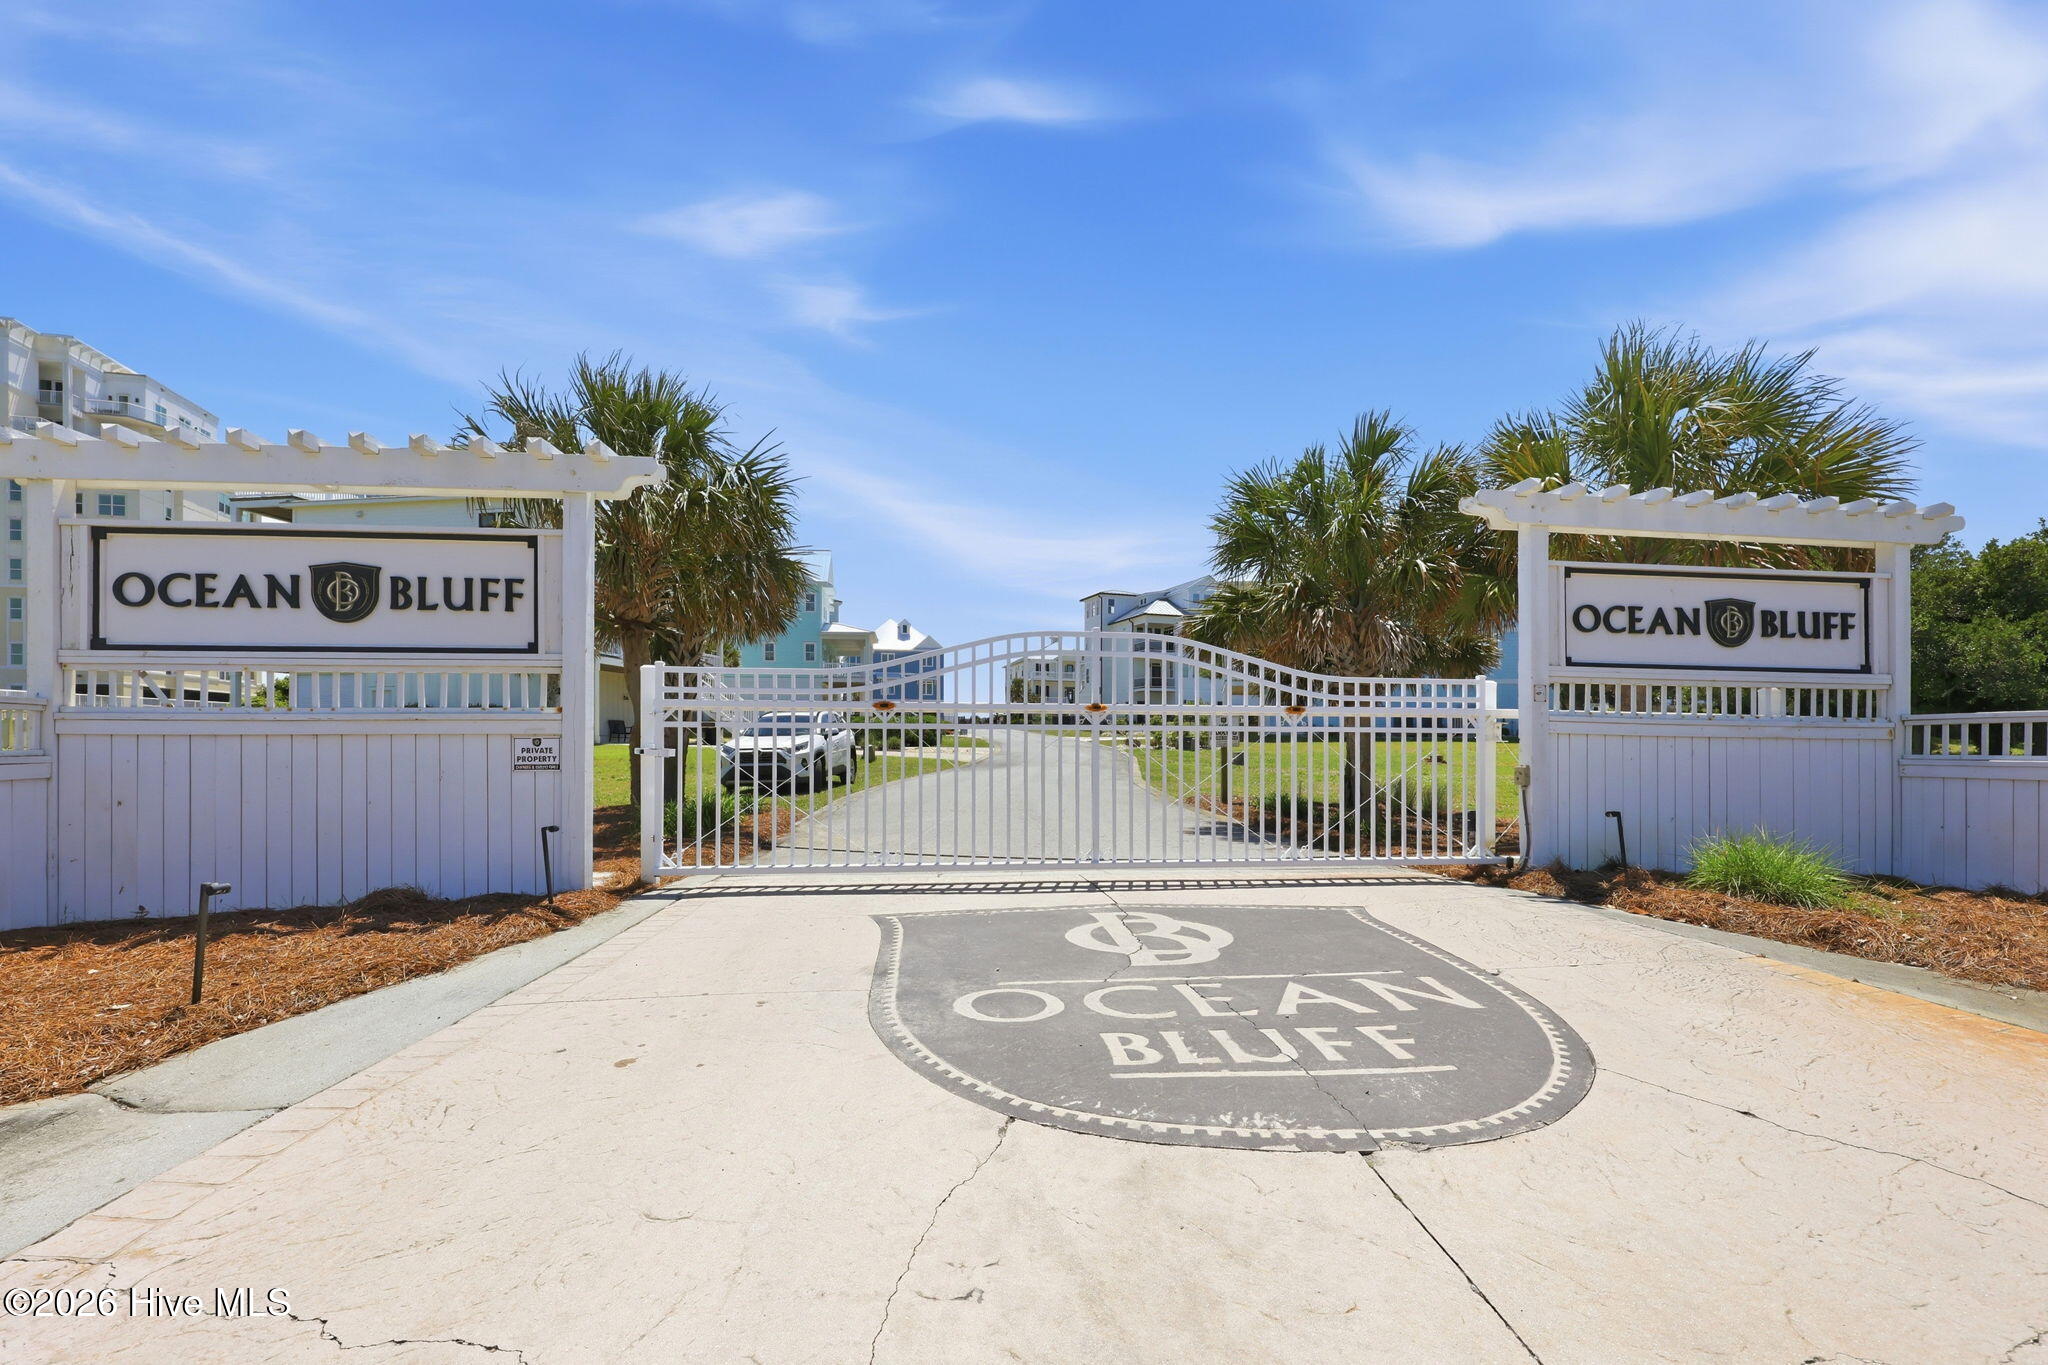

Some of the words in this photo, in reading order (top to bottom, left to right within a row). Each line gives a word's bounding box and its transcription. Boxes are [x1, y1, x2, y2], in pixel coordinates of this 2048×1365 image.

[111, 571, 301, 609] OCEAN
[389, 575, 525, 612] BLUFF
[1571, 604, 1702, 636] OCEAN
[1760, 609, 1857, 640] BLUFF
[516, 755, 557, 763] PROPERTY
[952, 975, 1487, 1022] OCEAN
[1100, 1024, 1416, 1066] BLUFF
